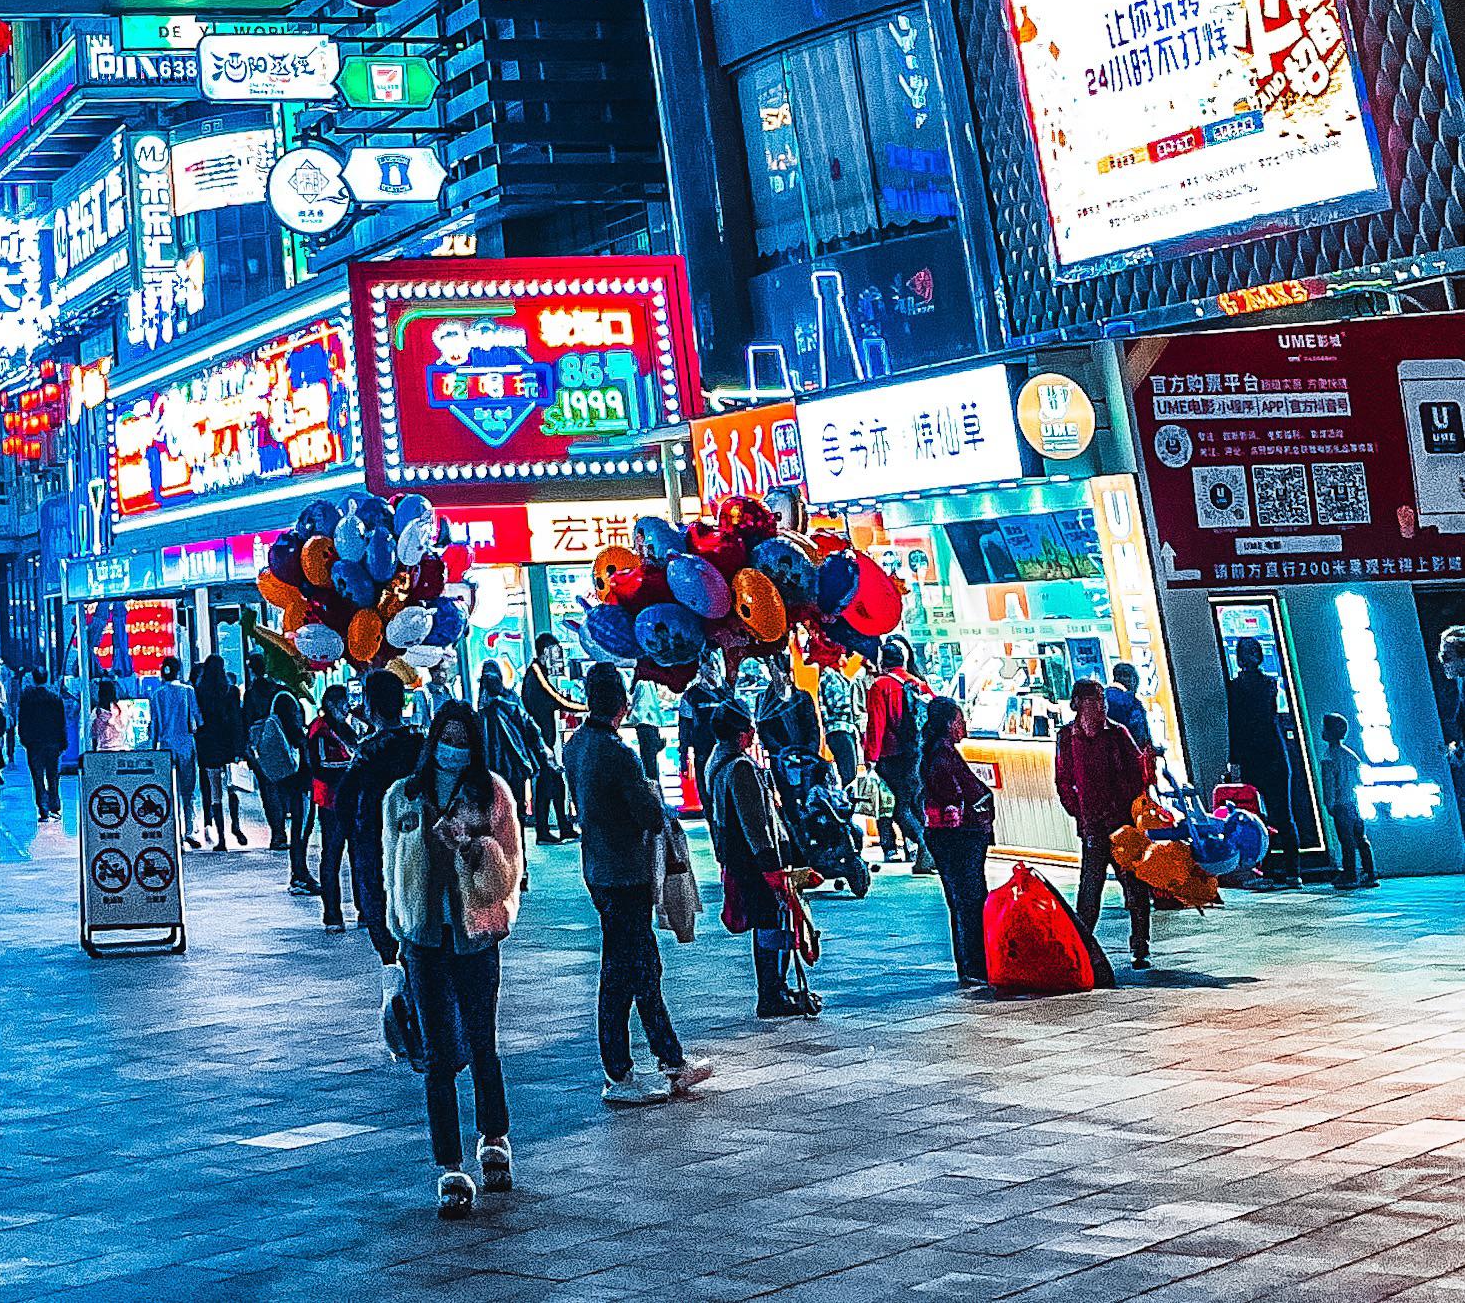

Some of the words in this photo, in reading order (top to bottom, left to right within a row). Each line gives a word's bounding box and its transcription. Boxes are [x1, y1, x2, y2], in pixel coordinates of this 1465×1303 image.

[158, 25, 182, 39] DE
[1084, 18, 1229, 96] 24小时不打烊
[559, 354, 604, 388] 86
[1149, 374, 1259, 393] 官方购票平台
[560, 389, 625, 420] 1999
[1040, 422, 1079, 438] UME
